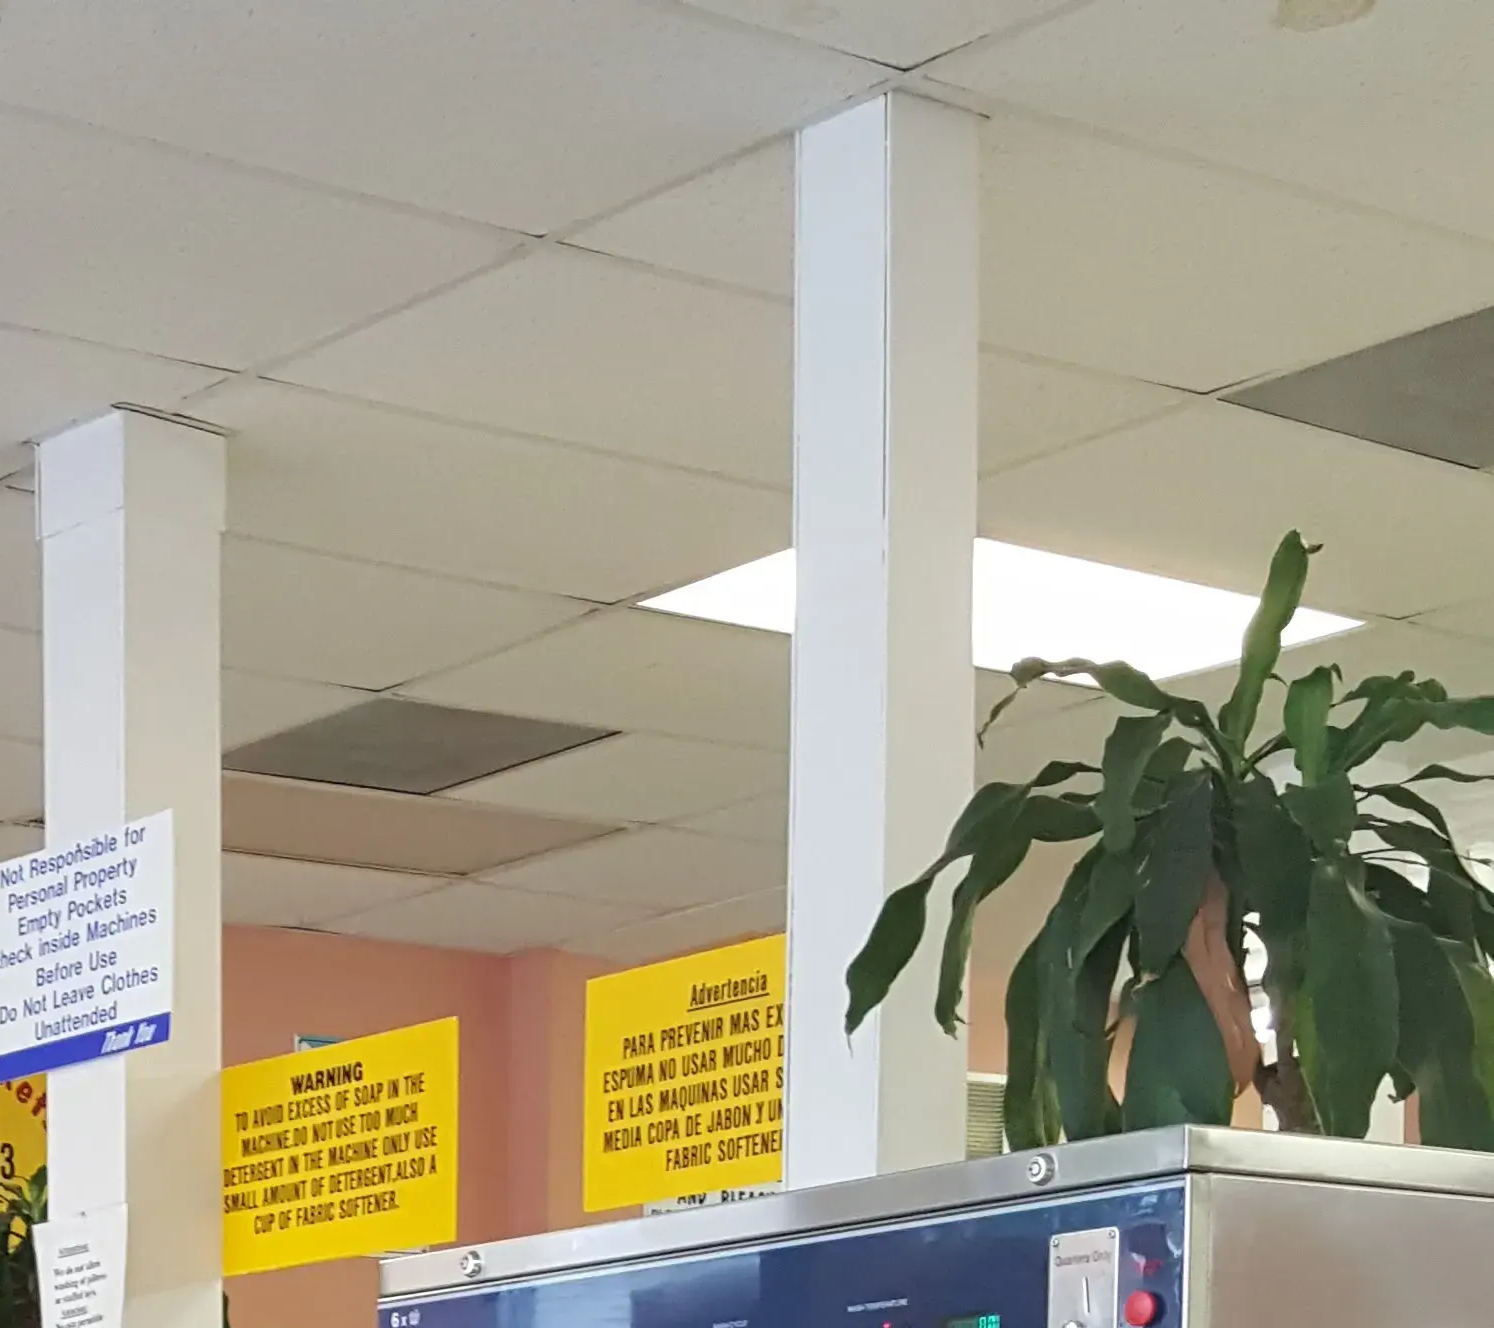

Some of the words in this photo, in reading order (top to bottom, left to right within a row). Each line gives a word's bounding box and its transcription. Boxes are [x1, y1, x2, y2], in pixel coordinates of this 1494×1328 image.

[0, 867, 24, 888] Not
[30, 835, 117, 880] Responsible
[125, 826, 145, 846] for
[8, 875, 67, 912] Personal
[74, 856, 137, 891] Property
[18, 909, 61, 936] Empty
[68, 887, 127, 921] Pockets
[39, 931, 80, 957] inside
[87, 907, 157, 942] Machines
[36, 961, 82, 987] Before
[90, 950, 117, 971] Use
[690, 970, 768, 1007] Advertencia
[0, 1006, 17, 1025] Do
[23, 995, 47, 1015] Not
[53, 984, 94, 1009] Leave
[102, 965, 158, 995] Clothes
[35, 1001, 117, 1040] Unattended
[623, 1032, 655, 1059] PARA
[660, 1017, 724, 1052] PREVENIR
[730, 1008, 760, 1036] MAS
[291, 1062, 363, 1095] WARNING
[603, 1065, 654, 1094] ESPUMA
[659, 1058, 676, 1081] NO
[682, 1050, 716, 1077] USAR
[723, 1039, 771, 1068] MUCHO
[234, 1110, 248, 1132] TO
[252, 1104, 283, 1129] AVOID
[288, 1094, 331, 1121] EXCESS
[335, 1089, 350, 1111] OF
[354, 1082, 383, 1107] SOAP
[387, 1078, 399, 1099] IN
[403, 1072, 425, 1095] THE
[608, 1099, 624, 1123] EN
[630, 1093, 653, 1118] LAS
[658, 1078, 728, 1112] MAQUINAS
[733, 1070, 769, 1097] USAR
[312, 1121, 333, 1143] NOT
[335, 1115, 356, 1138] USE
[359, 1110, 381, 1133] TOO
[385, 1102, 418, 1128] MUCH
[603, 1126, 642, 1153] MEDIA
[648, 1119, 680, 1145] COPA
[686, 1113, 702, 1136] DE
[707, 1104, 751, 1133] JABON
[755, 1103, 763, 1124] Y
[288, 1154, 299, 1174] IN
[303, 1150, 323, 1172] THE
[328, 1138, 378, 1167] MACHINE
[382, 1132, 410, 1156] ONLY
[414, 1126, 437, 1149] USE
[666, 1143, 712, 1171] FABRIC
[224, 1190, 258, 1214] SMALL
[263, 1180, 307, 1207] AMOUNT
[311, 1176, 325, 1198] OF
[429, 1154, 437, 1175] A
[254, 1213, 275, 1234] CUP
[279, 1209, 292, 1230] OF
[296, 1202, 334, 1228] FABRIC
